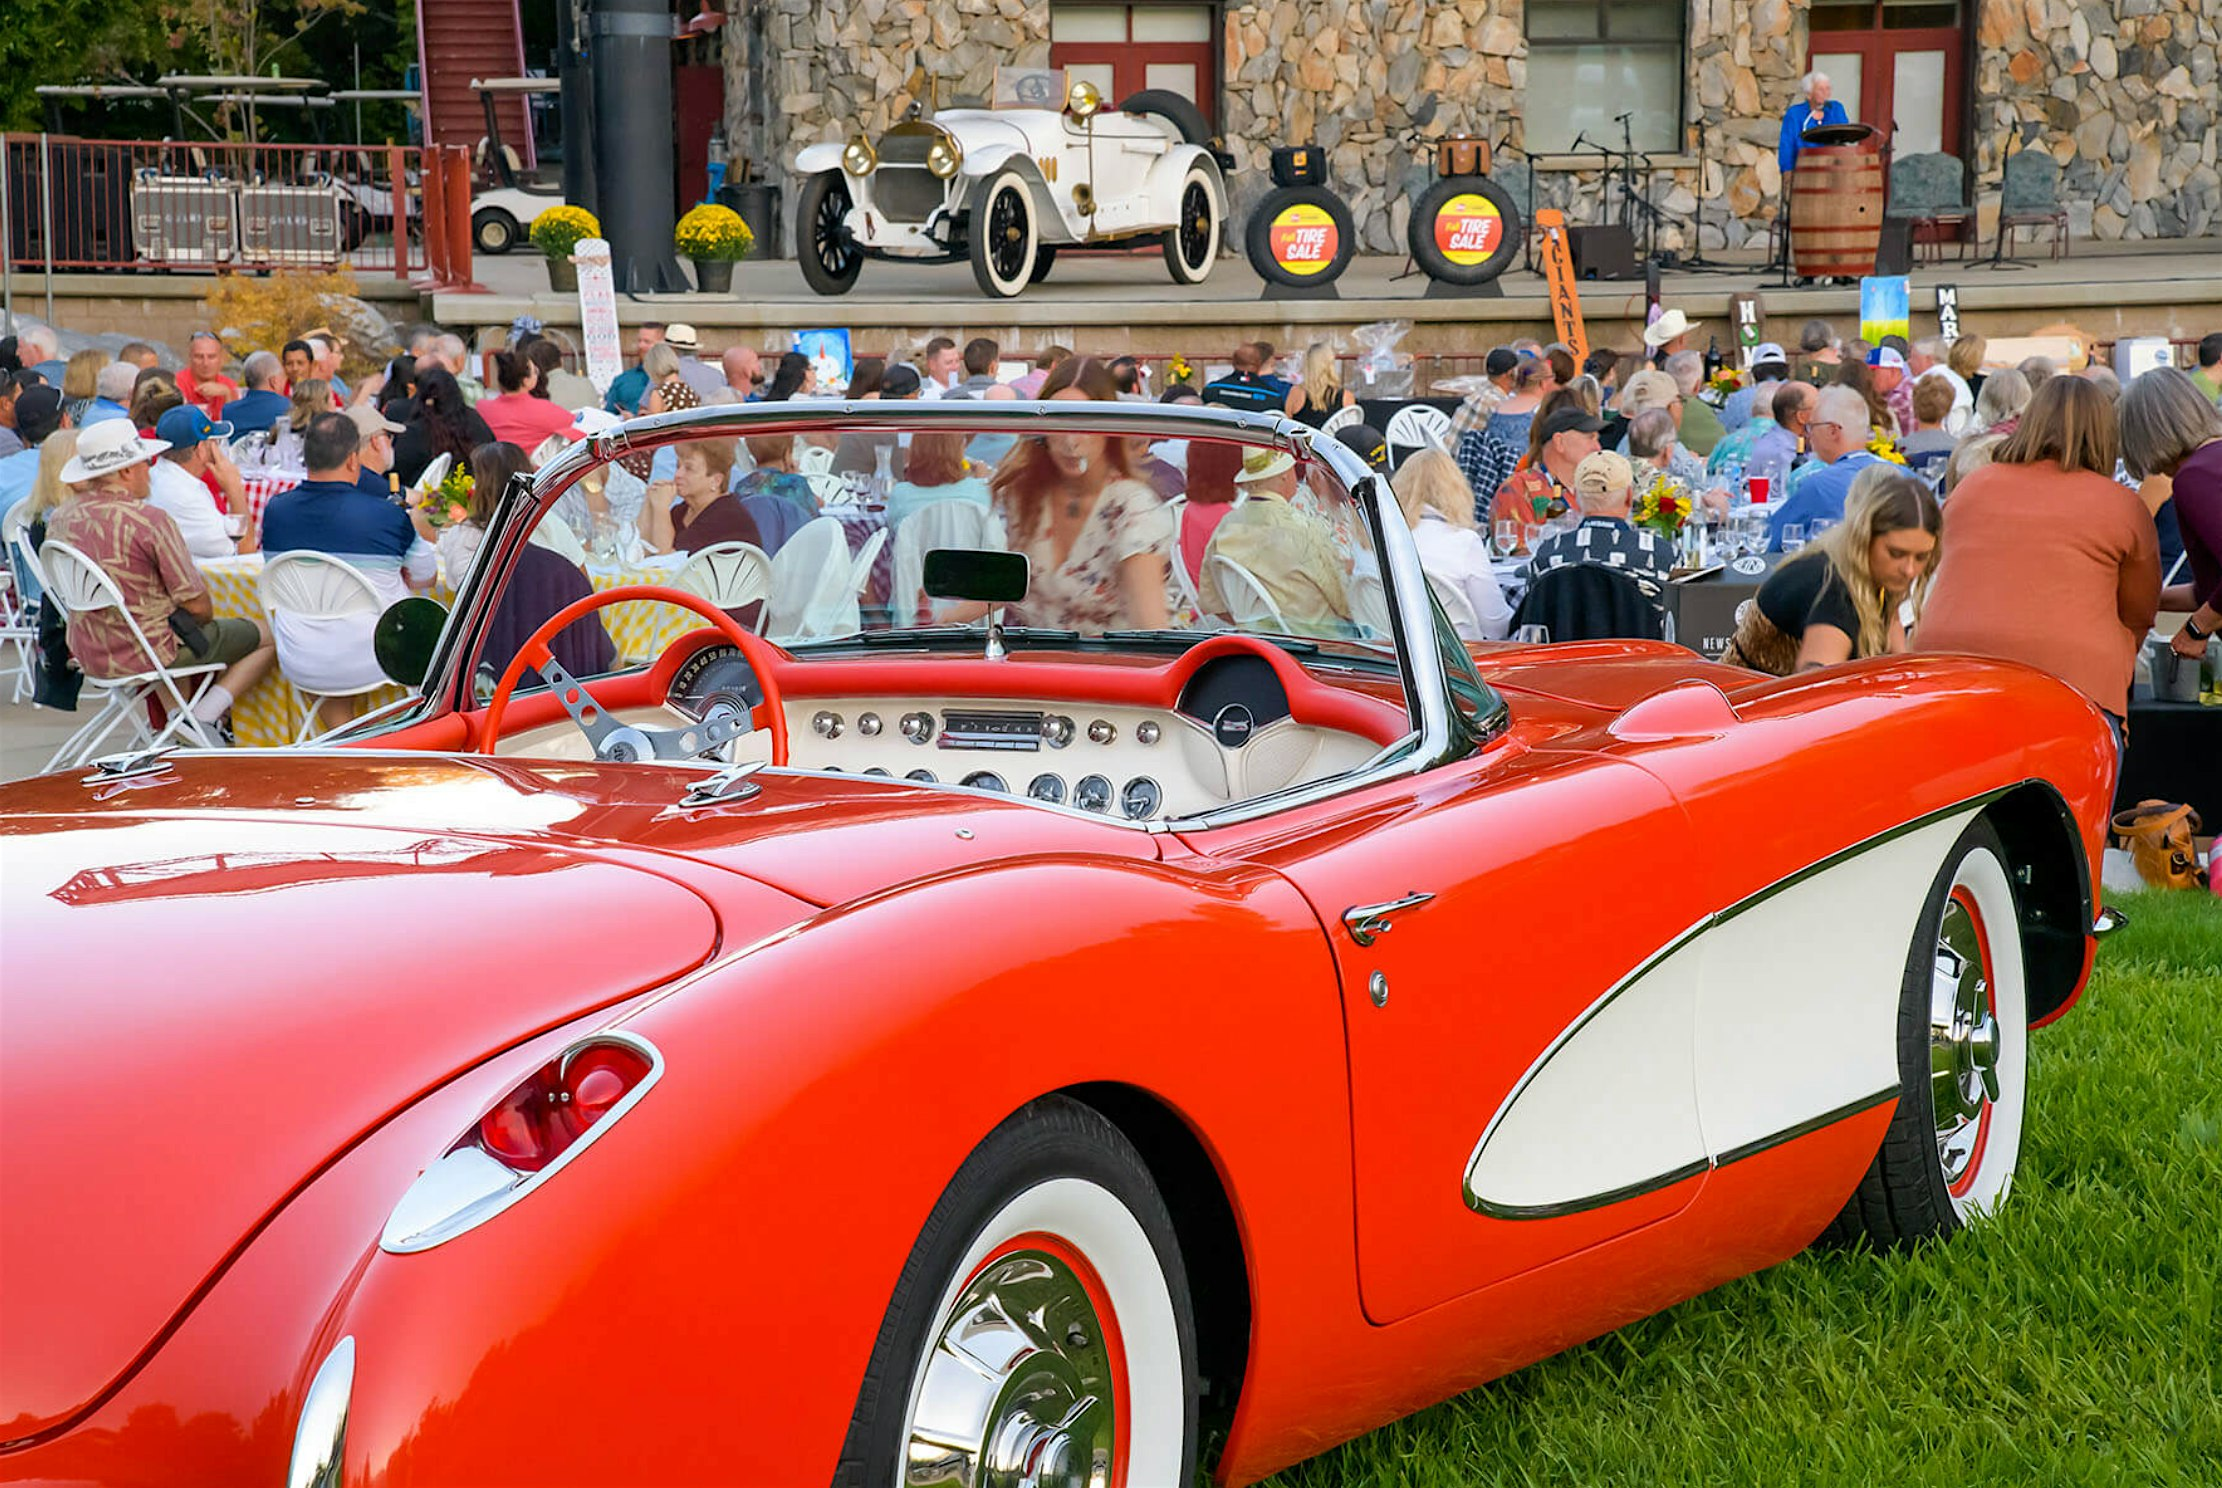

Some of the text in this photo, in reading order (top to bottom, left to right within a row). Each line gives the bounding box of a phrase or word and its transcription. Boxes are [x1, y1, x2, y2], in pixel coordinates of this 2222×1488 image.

[1460, 218, 1492, 235] TIRE
[1296, 228, 1328, 244] TIRE
[1449, 233, 1486, 250] SALE
[1285, 243, 1322, 260] SALE
[1552, 244, 1580, 356] GIANTS
[1938, 288, 1959, 347] MAR
